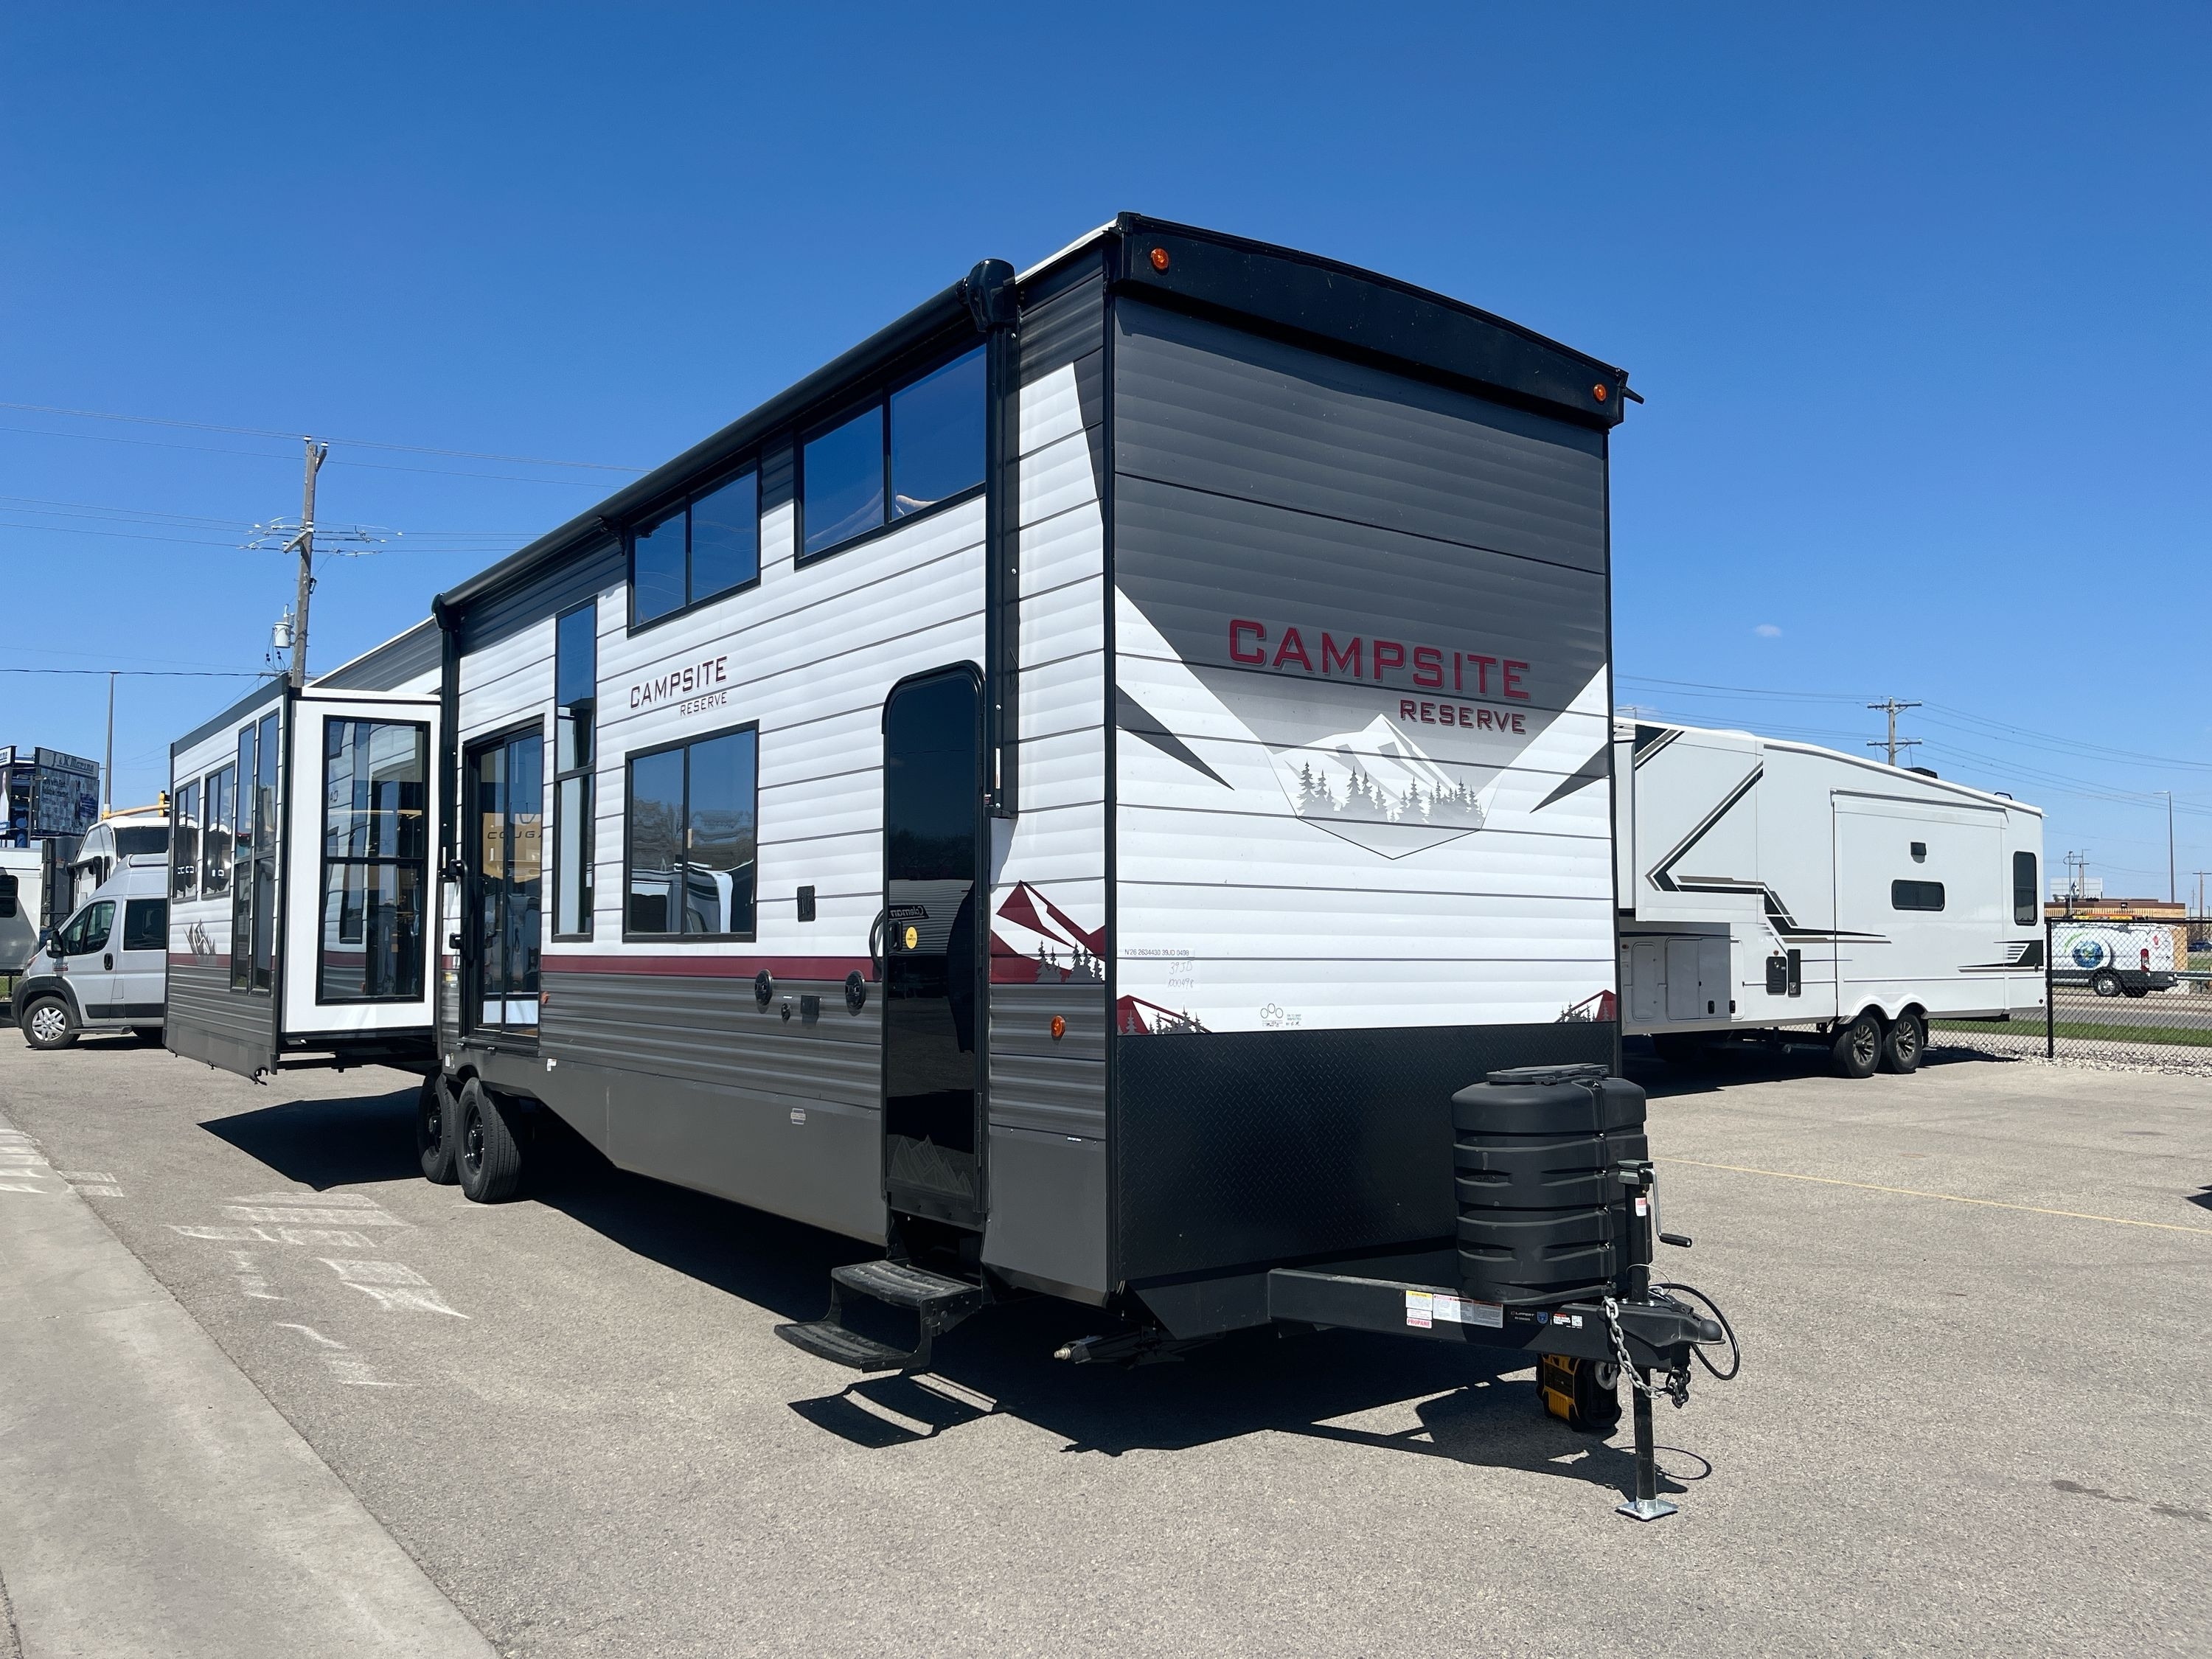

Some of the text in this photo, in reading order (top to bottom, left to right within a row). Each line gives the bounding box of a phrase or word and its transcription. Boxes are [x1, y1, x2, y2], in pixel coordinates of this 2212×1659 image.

[1229, 619, 1531, 700] CAMPSITE
[630, 655, 727, 709] CAMPSITE
[680, 692, 727, 716] RESERVE
[1399, 699, 1526, 735] RESERVE
[1408, 1318, 1430, 1327] PROPANE
